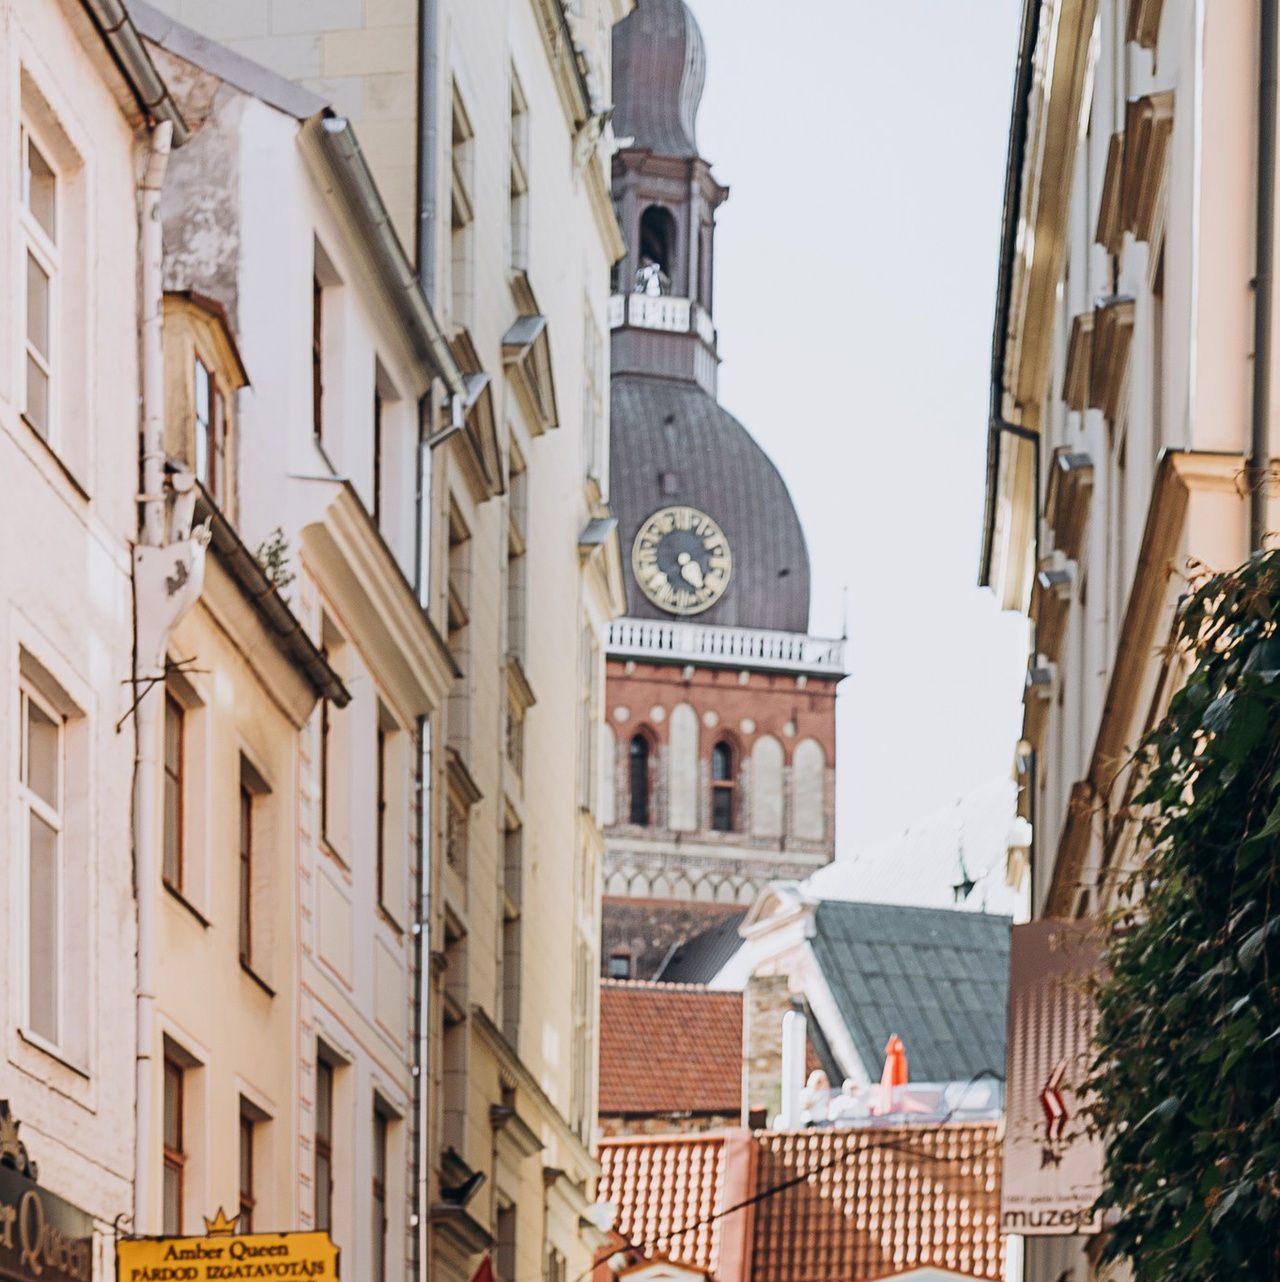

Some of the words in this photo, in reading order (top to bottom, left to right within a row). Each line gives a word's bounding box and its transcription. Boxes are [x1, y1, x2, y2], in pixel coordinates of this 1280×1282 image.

[19, 1190, 91, 1282] Queen
[164, 1243, 224, 1261] Amber
[229, 1241, 289, 1261] Queen
